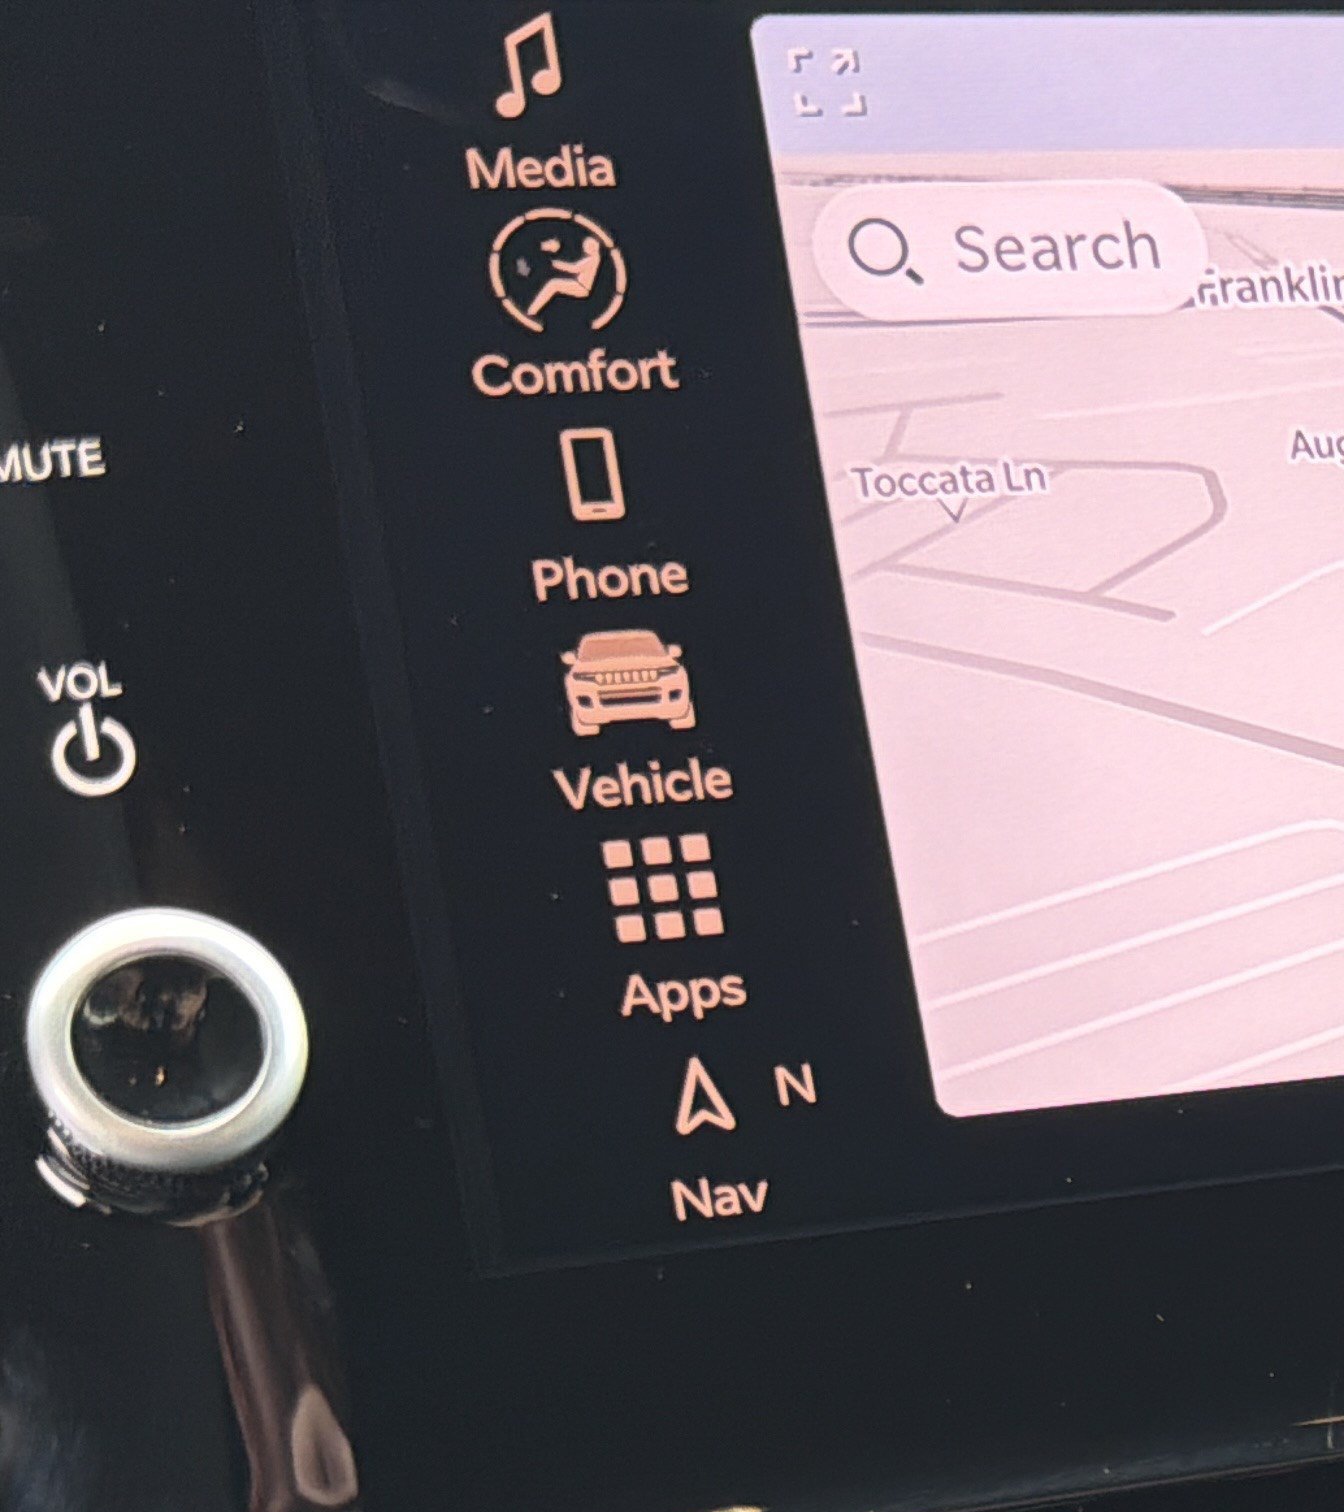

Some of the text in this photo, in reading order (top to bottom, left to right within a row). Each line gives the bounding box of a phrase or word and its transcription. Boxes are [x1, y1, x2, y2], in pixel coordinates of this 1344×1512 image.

[465, 145, 617, 190] Media
[955, 219, 1162, 274] Search
[472, 349, 679, 397] Comfort
[0, 437, 106, 482] MUTE
[851, 463, 1046, 499] Toccata Ln
[531, 556, 690, 602] Phone
[36, 662, 124, 701] VOL
[553, 757, 734, 811] Vehicle
[620, 973, 747, 1023] Apps
[774, 1062, 817, 1107] N
[671, 1178, 768, 1222] Nav
